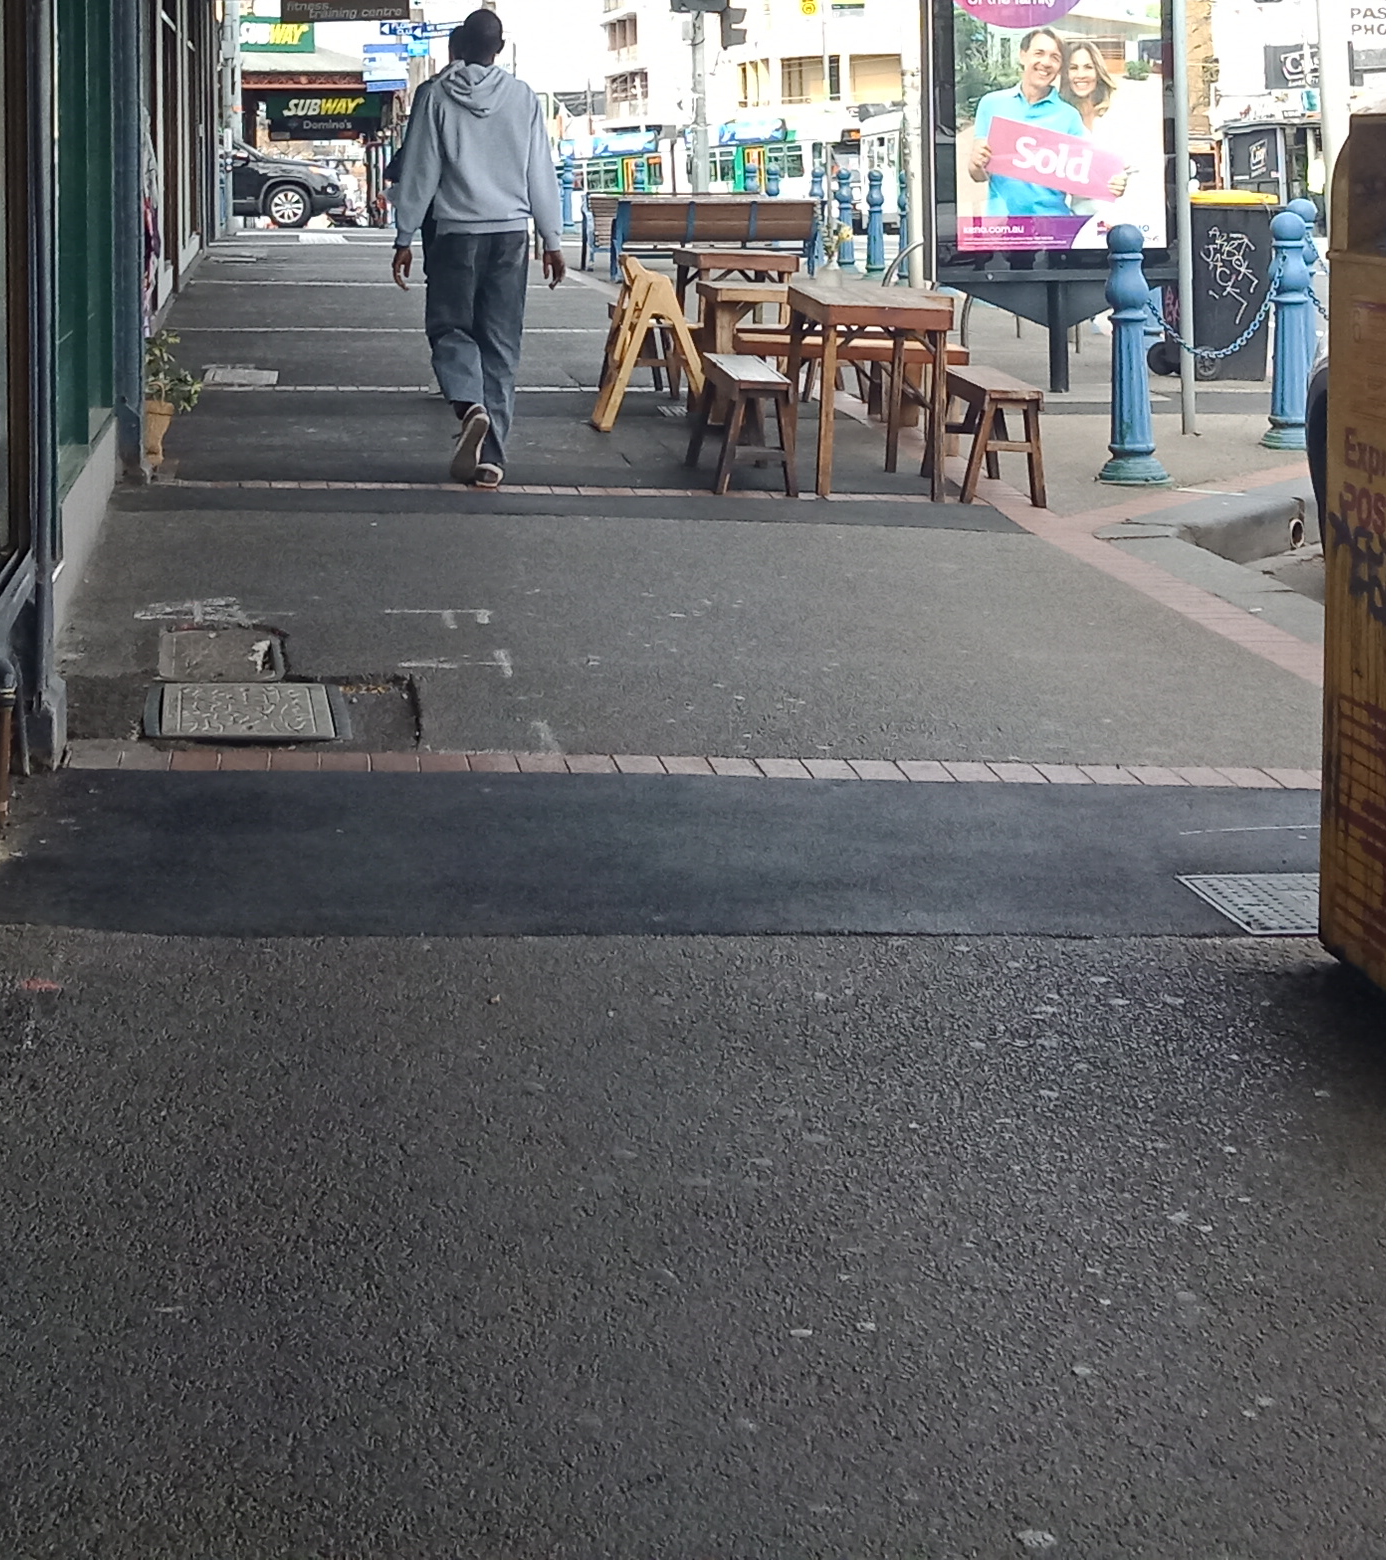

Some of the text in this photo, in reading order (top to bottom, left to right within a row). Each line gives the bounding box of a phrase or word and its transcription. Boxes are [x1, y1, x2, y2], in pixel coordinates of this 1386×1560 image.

[309, 7, 357, 19] training
[240, 22, 308, 44] SUBWAY
[283, 97, 365, 116] SUBWAY
[303, 119, 352, 129] Domino's
[1012, 136, 1094, 184] Sold
